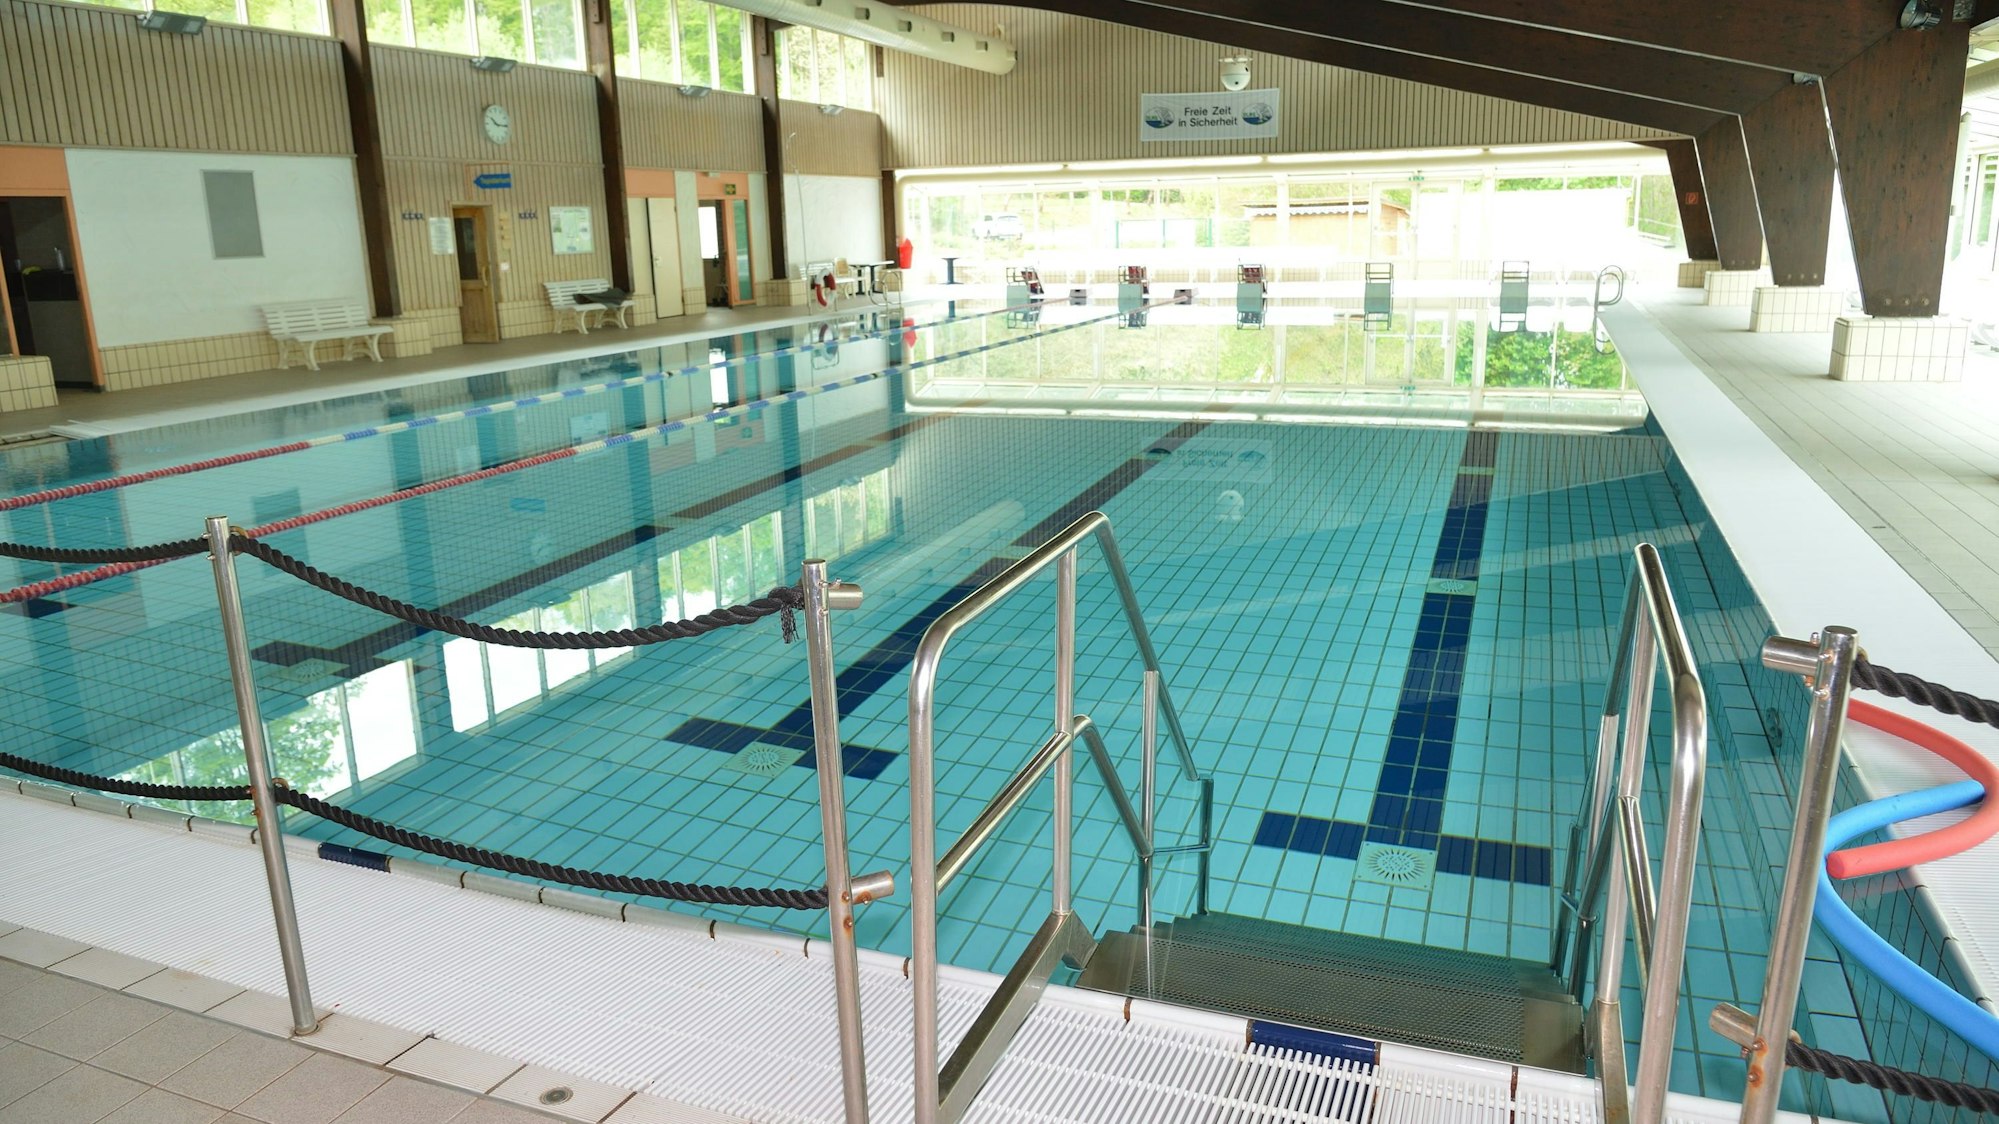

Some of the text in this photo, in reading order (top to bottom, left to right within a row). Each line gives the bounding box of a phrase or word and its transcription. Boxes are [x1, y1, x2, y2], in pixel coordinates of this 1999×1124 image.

[1184, 106, 1232, 116] Freie Zeit
[1178, 117, 1238, 127] in Sicherheit
